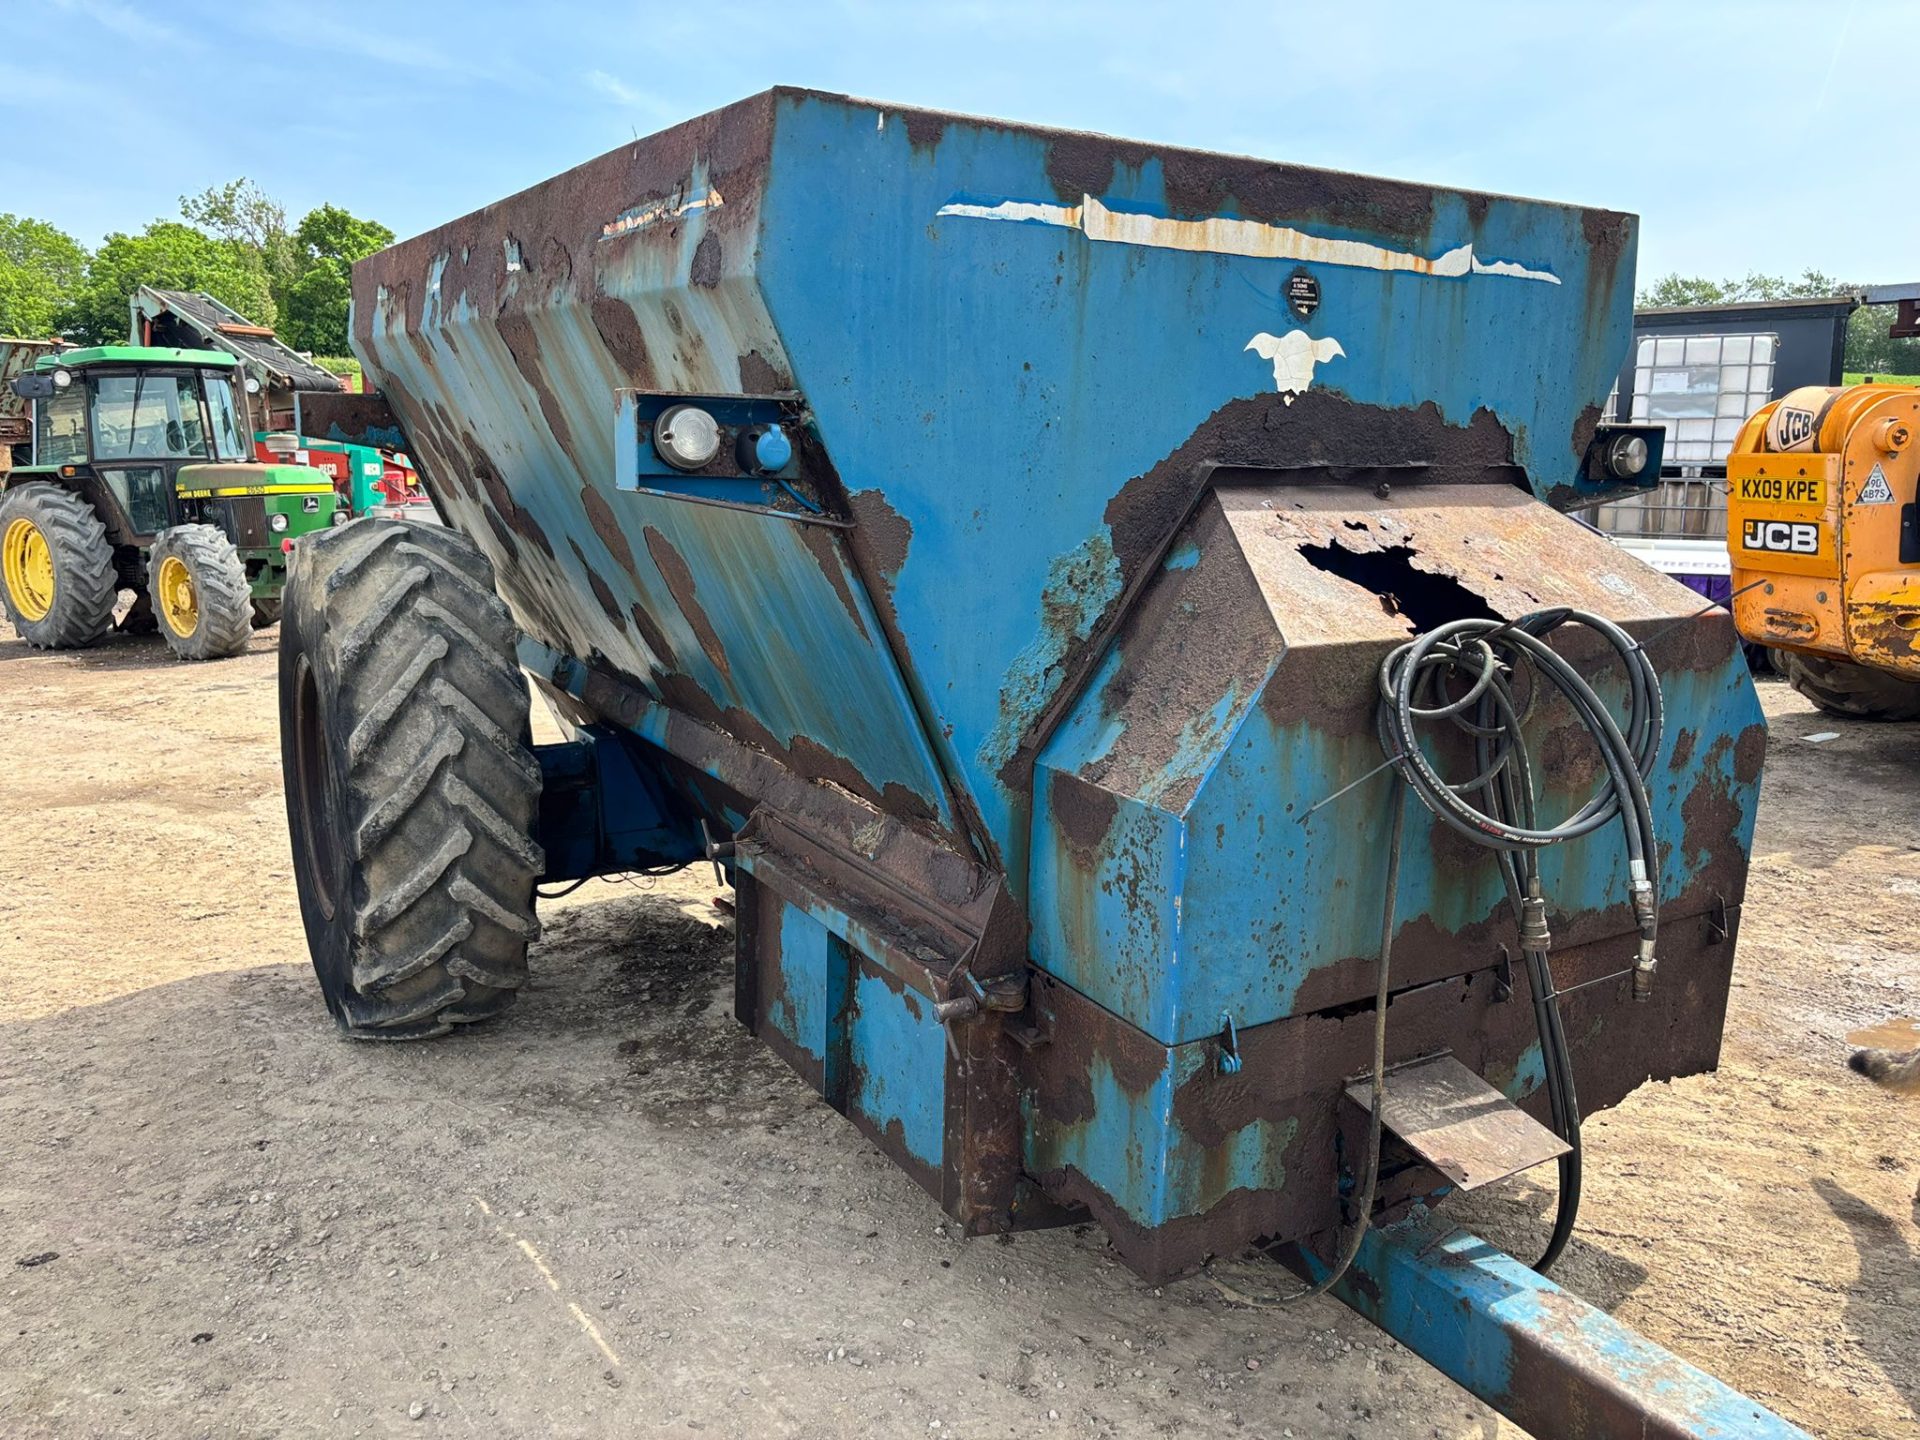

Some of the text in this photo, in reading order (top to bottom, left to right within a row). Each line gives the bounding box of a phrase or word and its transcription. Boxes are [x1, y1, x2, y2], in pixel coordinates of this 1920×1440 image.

[1780, 411, 1811, 446] JCB
[1742, 479, 1818, 501] KX09 KPE
[1745, 521, 1818, 553] JCB
